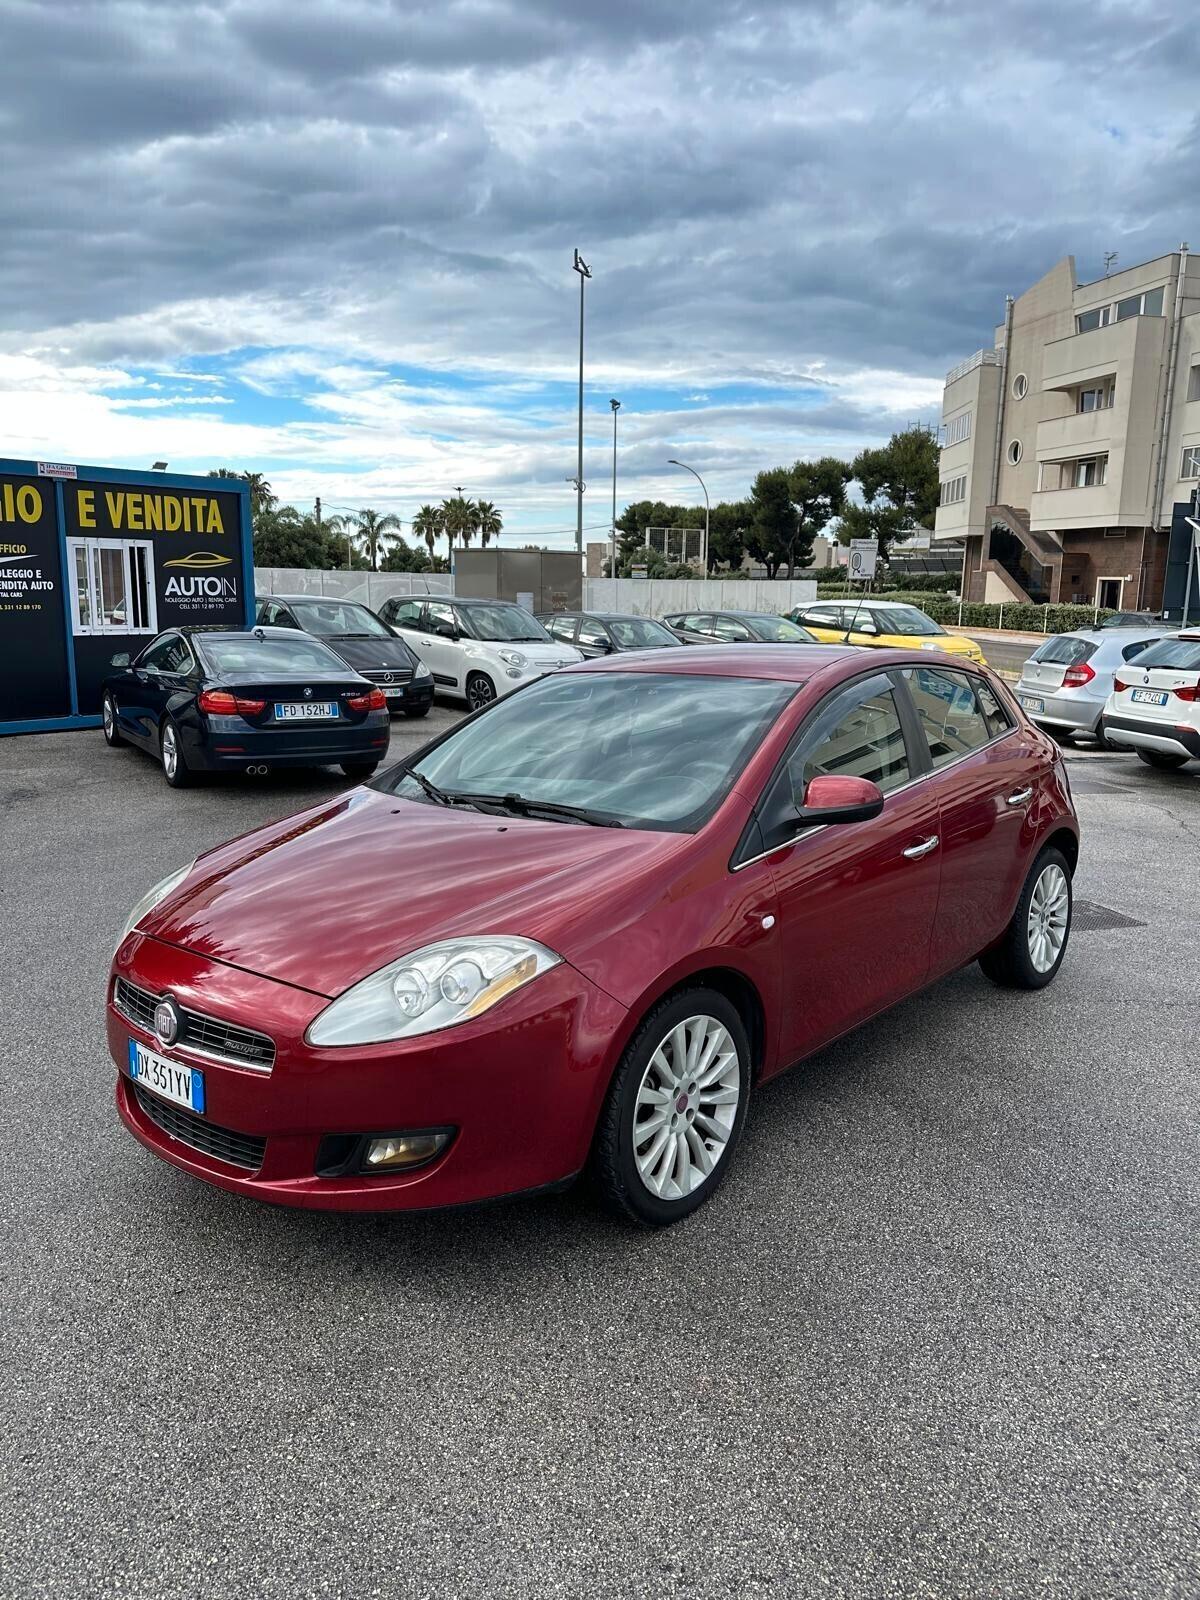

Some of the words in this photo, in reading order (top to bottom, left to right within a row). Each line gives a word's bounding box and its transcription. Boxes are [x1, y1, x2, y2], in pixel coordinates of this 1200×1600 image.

[0, 484, 43, 524] IO
[77, 489, 97, 528] E
[105, 491, 225, 534] VENDITA
[36, 569, 42, 579] E
[30, 581, 54, 590] AUTO
[283, 705, 297, 716] FD
[300, 704, 332, 716] 152HJ
[158, 1013, 171, 1034] FIAT
[137, 1051, 150, 1081] DX
[152, 1059, 191, 1101] 351YV
